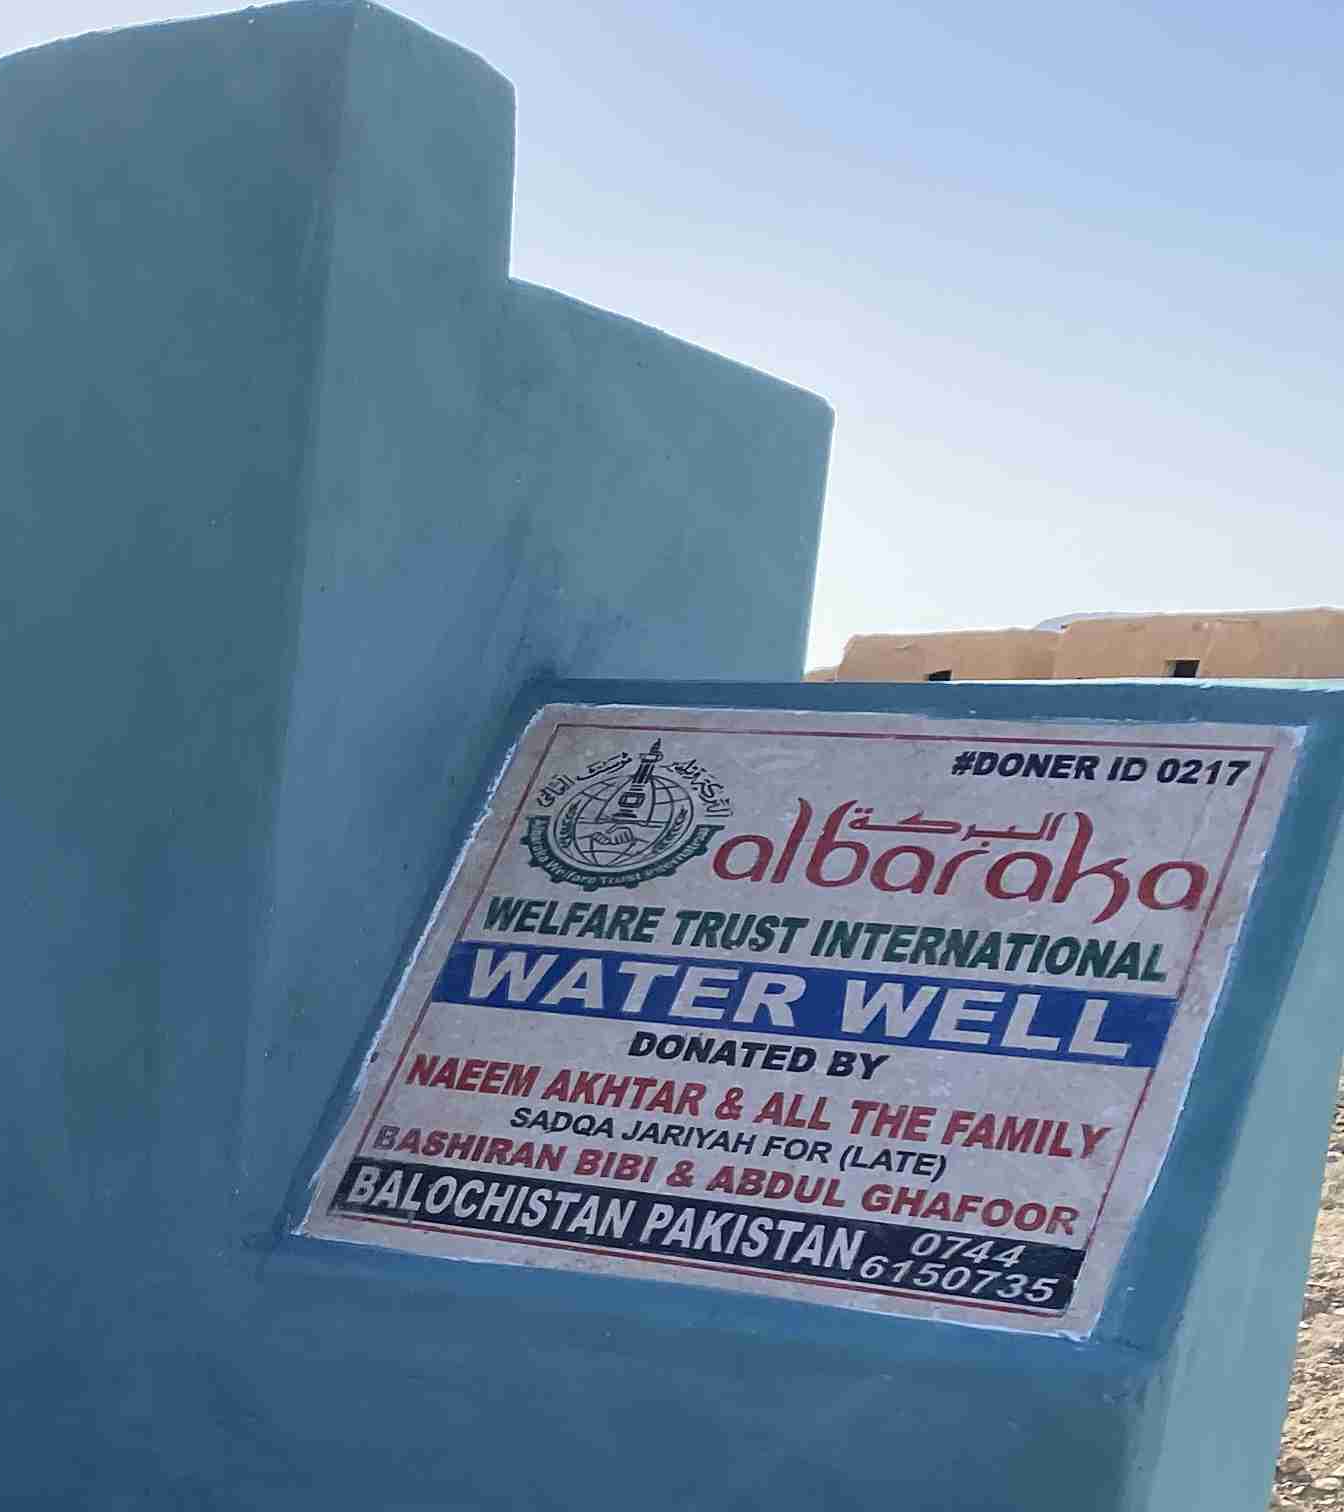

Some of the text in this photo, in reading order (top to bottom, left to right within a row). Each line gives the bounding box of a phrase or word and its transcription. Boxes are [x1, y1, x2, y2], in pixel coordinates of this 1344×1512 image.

[952, 751, 1251, 788] #DONER ID 0217
[482, 896, 1168, 982] WELFARE TRUST INTERNATIONAL
[467, 948, 1133, 1060] WATER WELL
[627, 1030, 892, 1081] DONATED BY
[404, 1053, 1113, 1160] NAEEM AKHTAR & ALL THE FAMILY
[509, 1106, 948, 1183] SADQA JARIYAH FOR (LATE)
[347, 1165, 866, 1272] BALOCHISTAN PAKISTAN
[372, 1123, 1081, 1236] BASHIRAN BIBI & ABDUL GHAFOOR
[859, 1254, 1060, 1303] 6150735
[911, 1231, 1027, 1269] 0744
